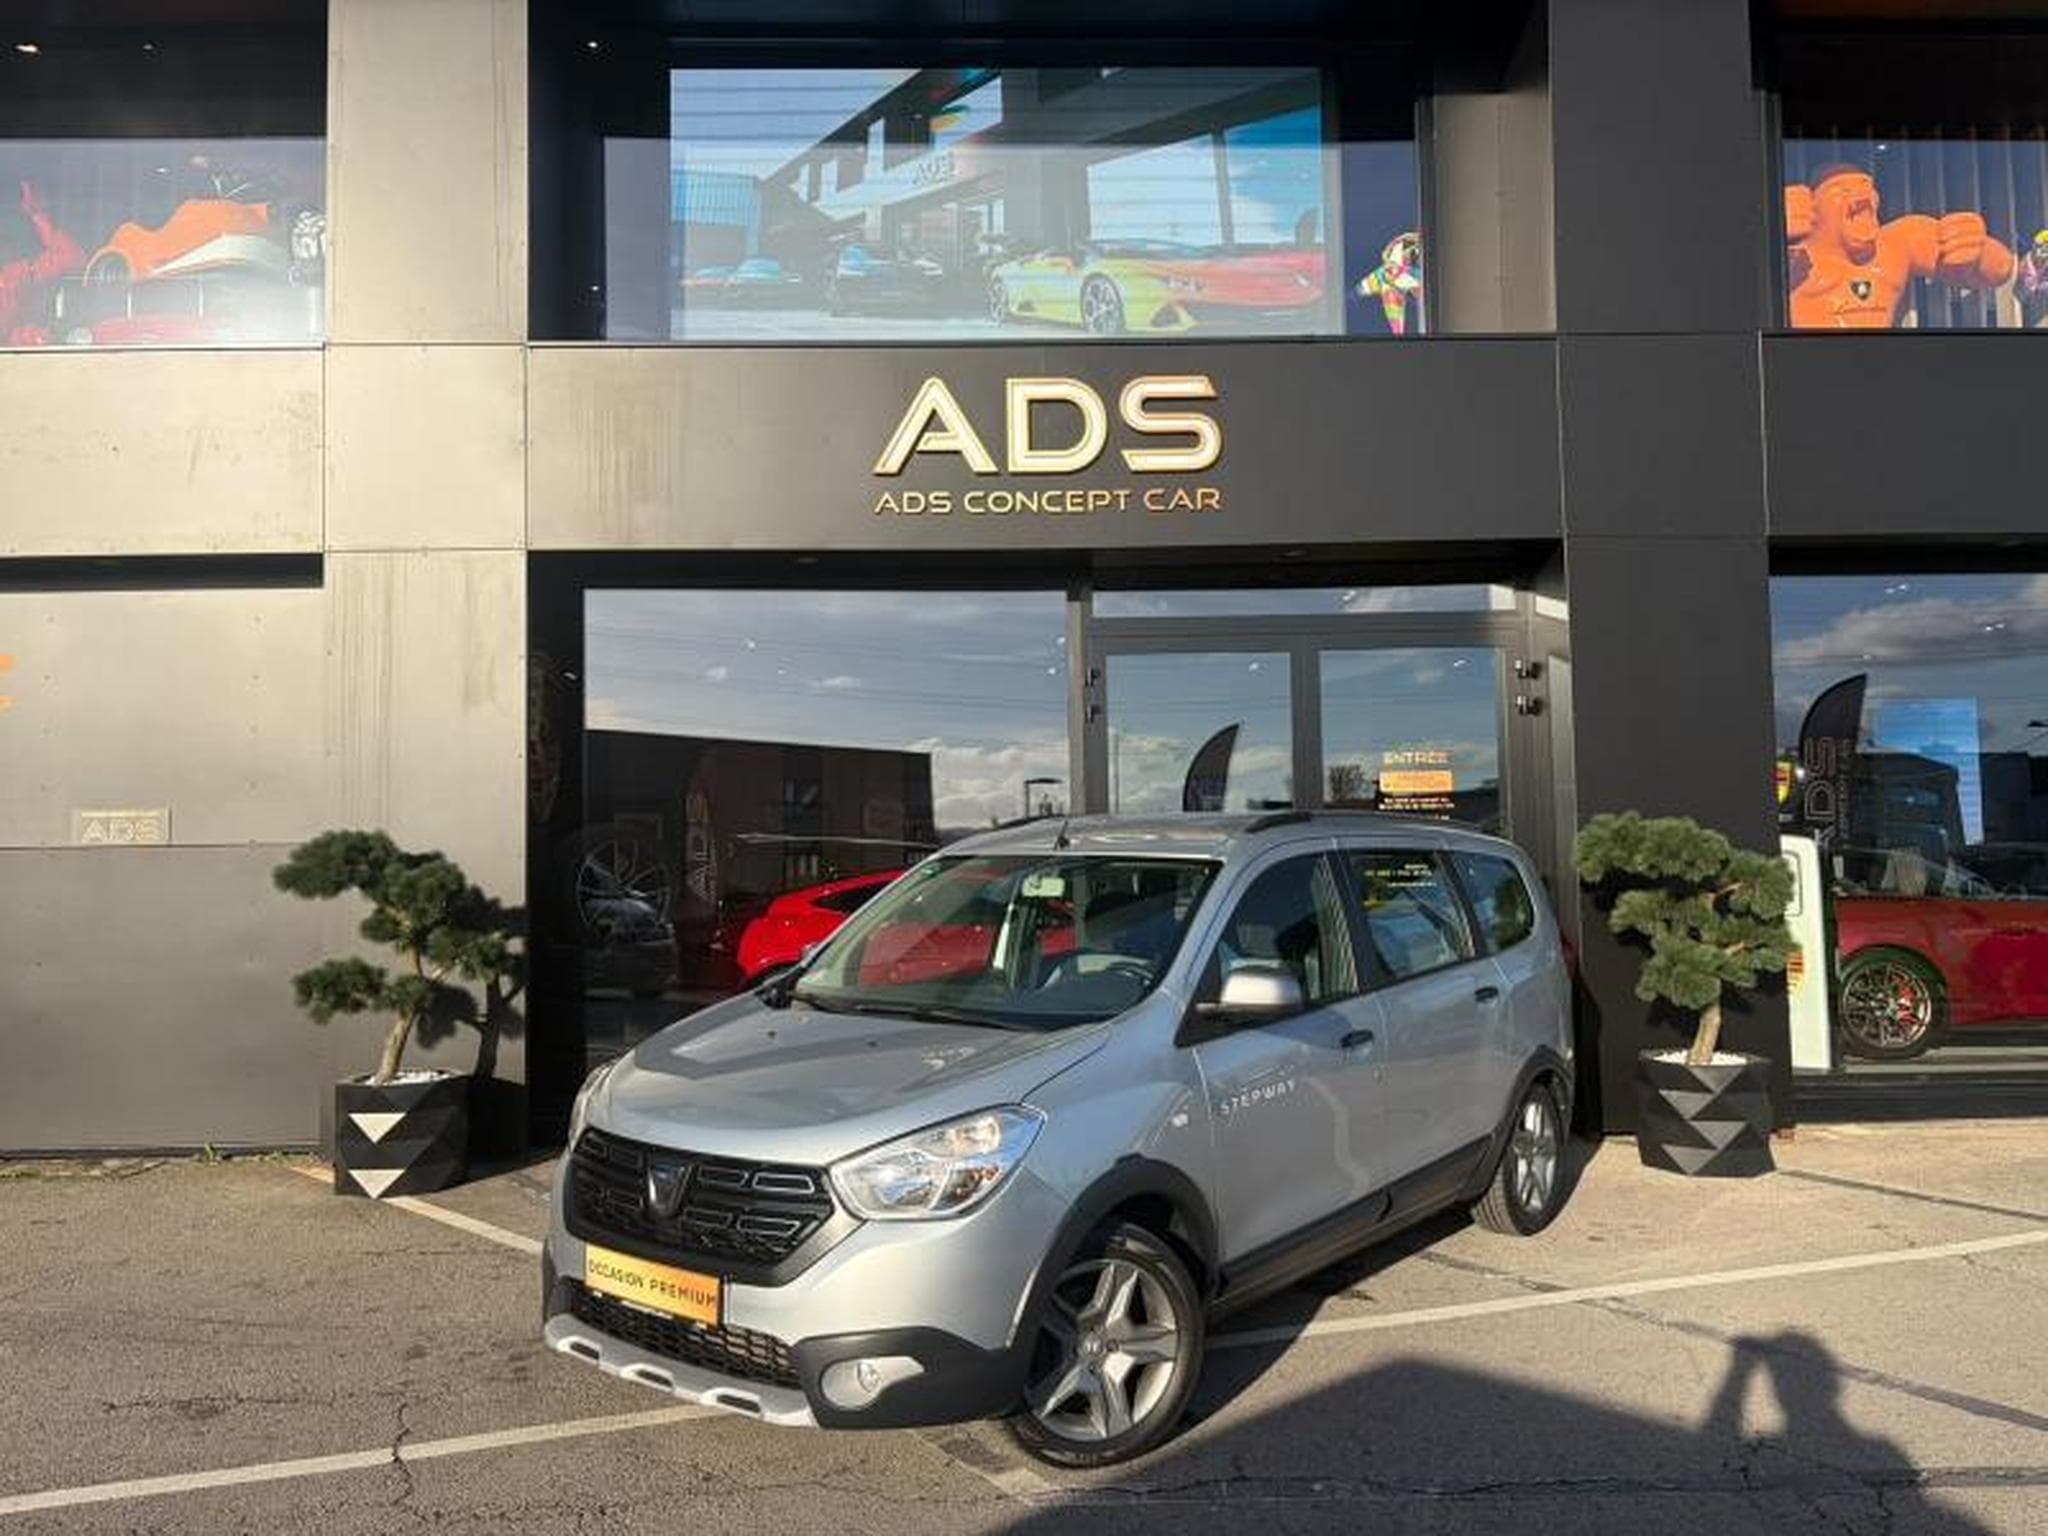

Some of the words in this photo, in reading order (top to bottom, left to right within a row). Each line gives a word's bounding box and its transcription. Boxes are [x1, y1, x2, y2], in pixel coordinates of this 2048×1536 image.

[873, 374, 1223, 476] ADS
[874, 492, 952, 515] ADS
[963, 489, 1130, 514] CONCEPT
[1143, 487, 1222, 512] CAR
[81, 818, 163, 843] ADS
[1220, 1079, 1296, 1115] STEPWAY
[589, 1259, 644, 1288] OCCASION
[650, 1278, 716, 1308] PREMIUM
